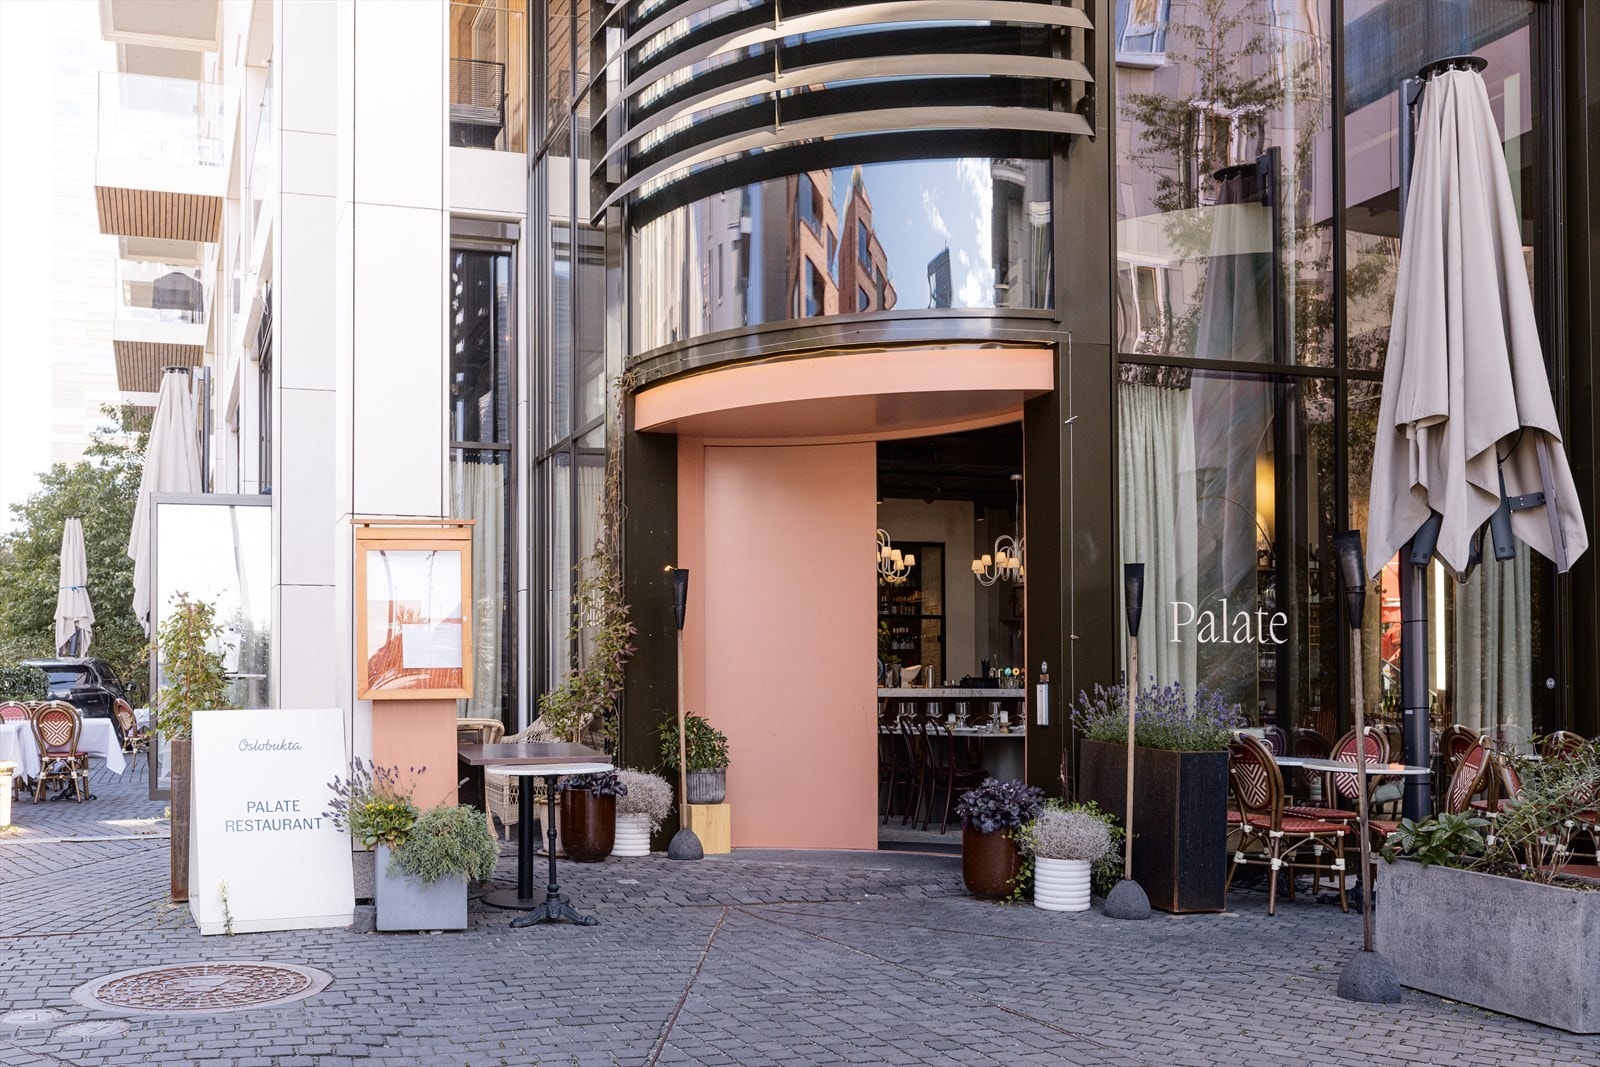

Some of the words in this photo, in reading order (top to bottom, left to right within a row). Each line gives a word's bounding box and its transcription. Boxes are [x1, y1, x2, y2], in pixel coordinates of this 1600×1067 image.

[1169, 598, 1289, 645] Palate
[238, 738, 302, 752] Oslobukta
[246, 800, 301, 813] PALATE
[224, 817, 322, 832] RESTAURANT
